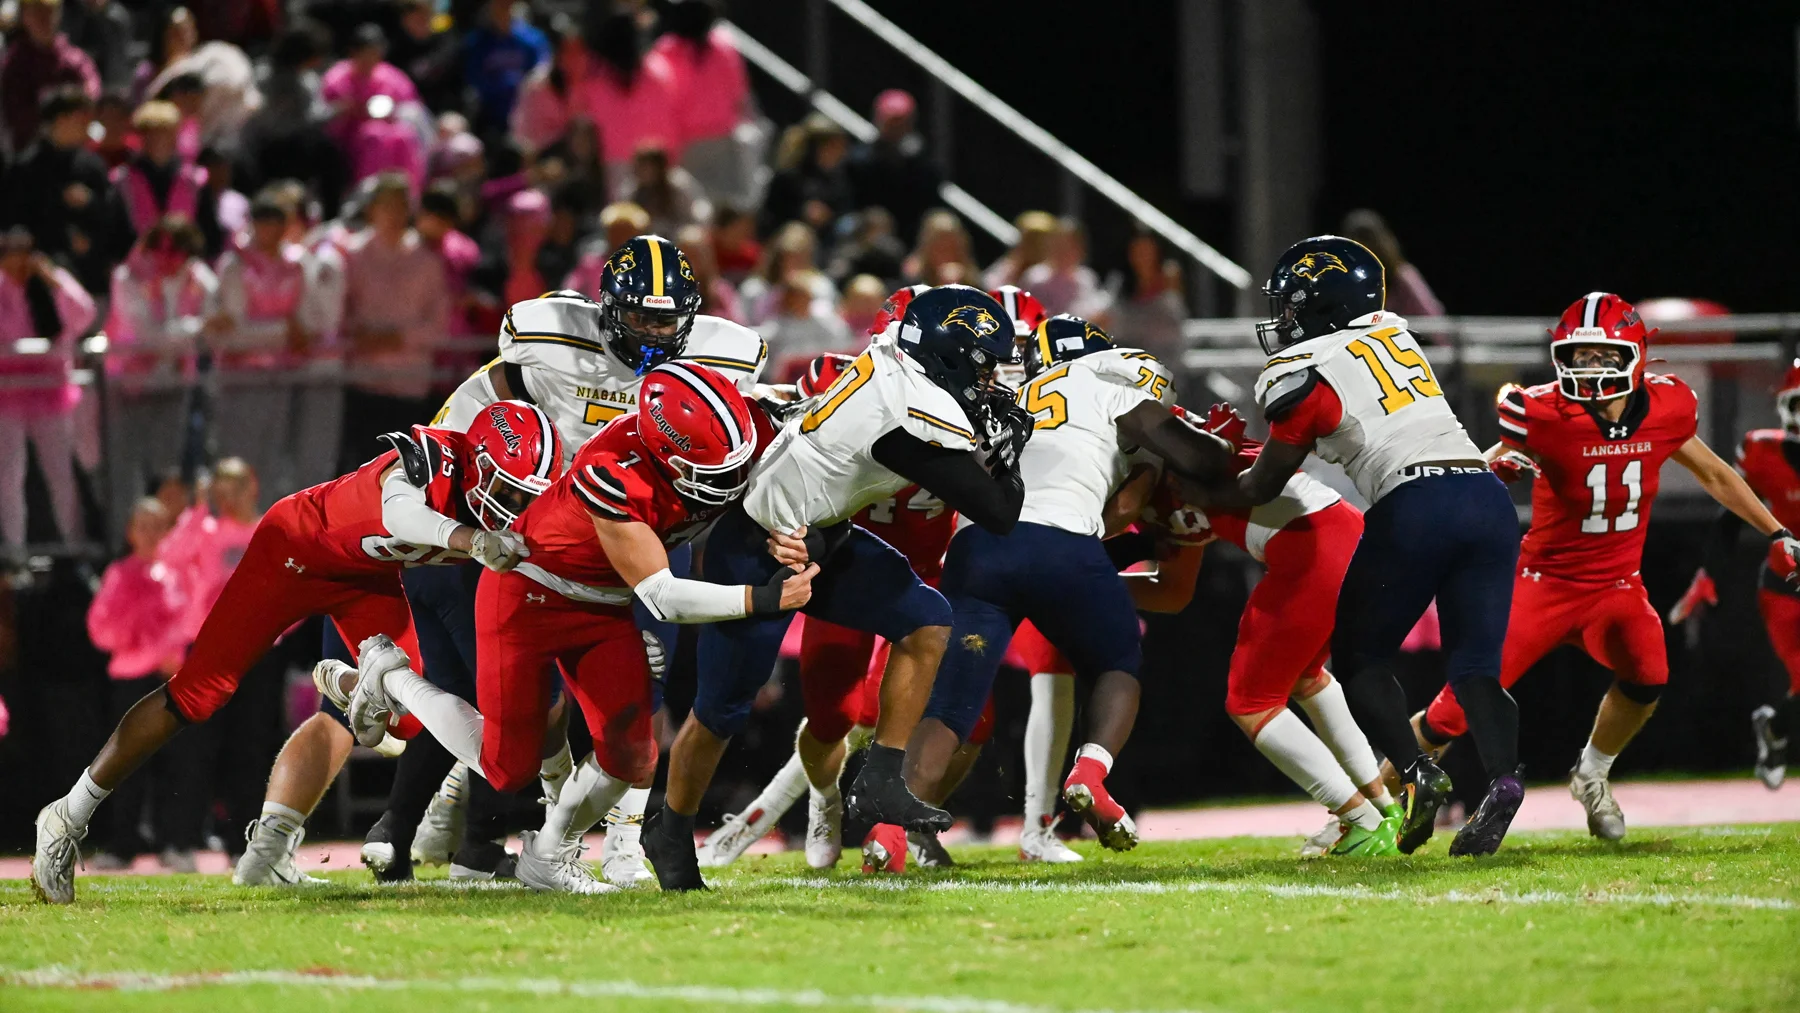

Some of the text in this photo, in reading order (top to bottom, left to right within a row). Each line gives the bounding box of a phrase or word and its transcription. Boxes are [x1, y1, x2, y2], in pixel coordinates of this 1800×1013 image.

[645, 297, 672, 305] Riddell
[1137, 366, 1170, 401] 75
[1345, 327, 1444, 416] 15
[576, 386, 636, 405] NIAGARA
[1015, 365, 1069, 430] 5
[490, 406, 522, 450] Legends
[650, 403, 692, 452] Legends
[617, 450, 642, 470] 7
[1582, 442, 1652, 457] LANCASTER
[1581, 460, 1642, 534] 11
